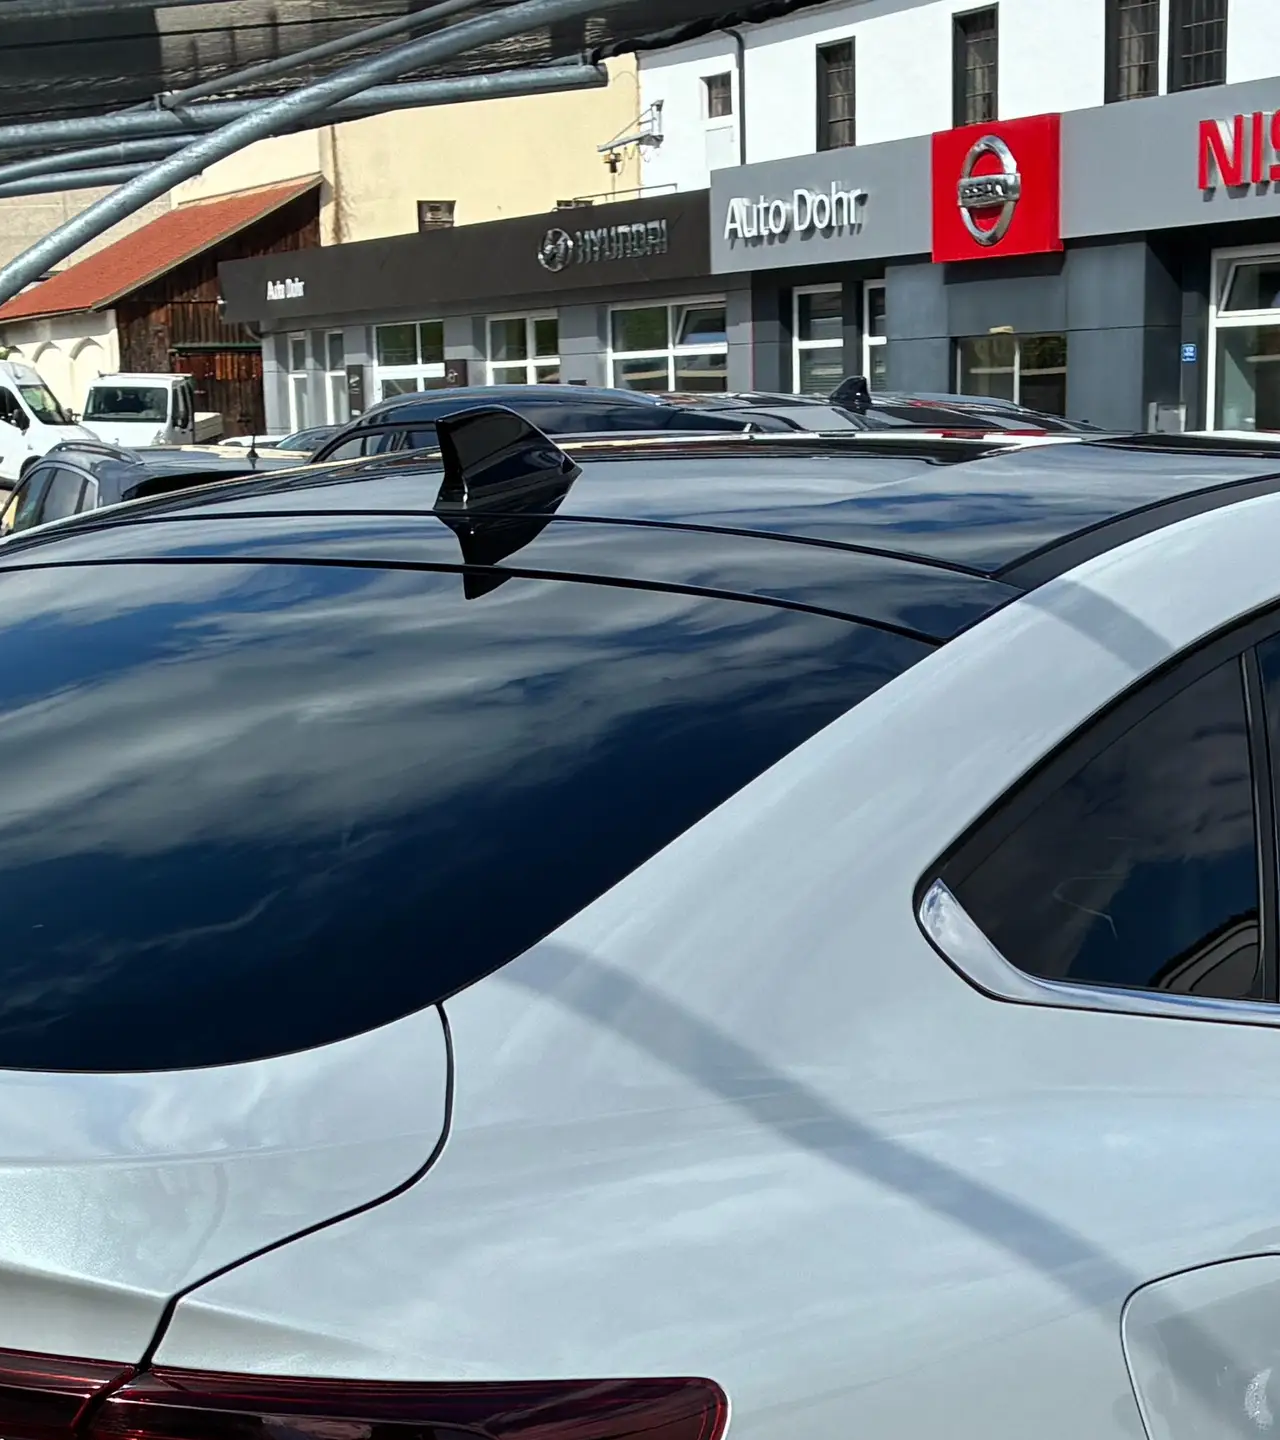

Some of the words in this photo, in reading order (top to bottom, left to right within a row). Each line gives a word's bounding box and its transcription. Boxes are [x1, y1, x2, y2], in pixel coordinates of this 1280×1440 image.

[723, 196, 787, 241] Auto
[793, 180, 864, 232] Dohr
[575, 219, 668, 263] HYUNDAI
